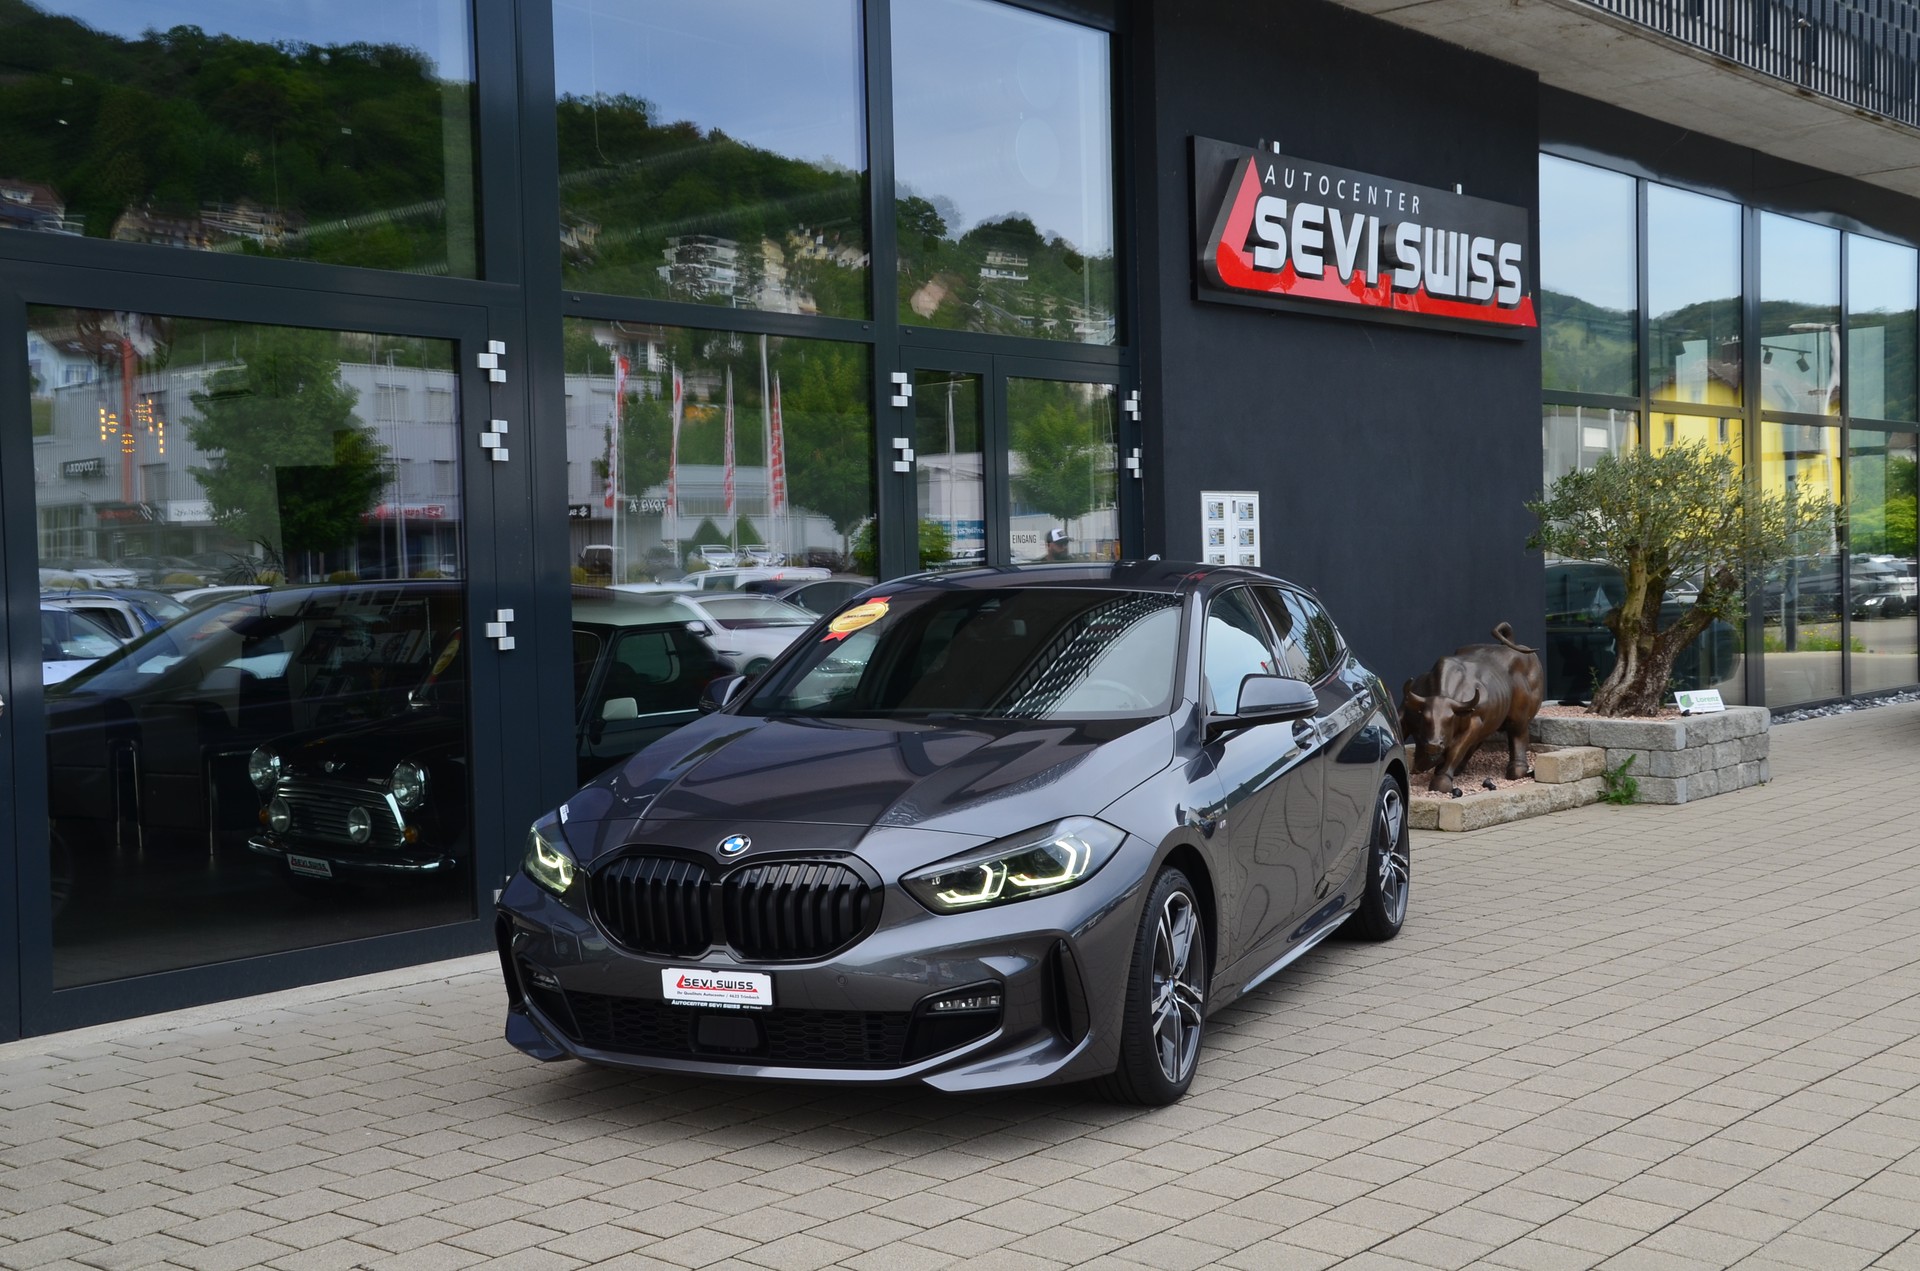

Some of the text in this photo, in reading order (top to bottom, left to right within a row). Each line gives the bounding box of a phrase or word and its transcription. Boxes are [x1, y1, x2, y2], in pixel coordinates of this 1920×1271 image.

[1264, 164, 1420, 215] AUTOCENTER
[1253, 195, 1522, 305] SEVI SWISS
[1012, 534, 1037, 544] EINGANG
[684, 978, 753, 989] SEVI SWISS
